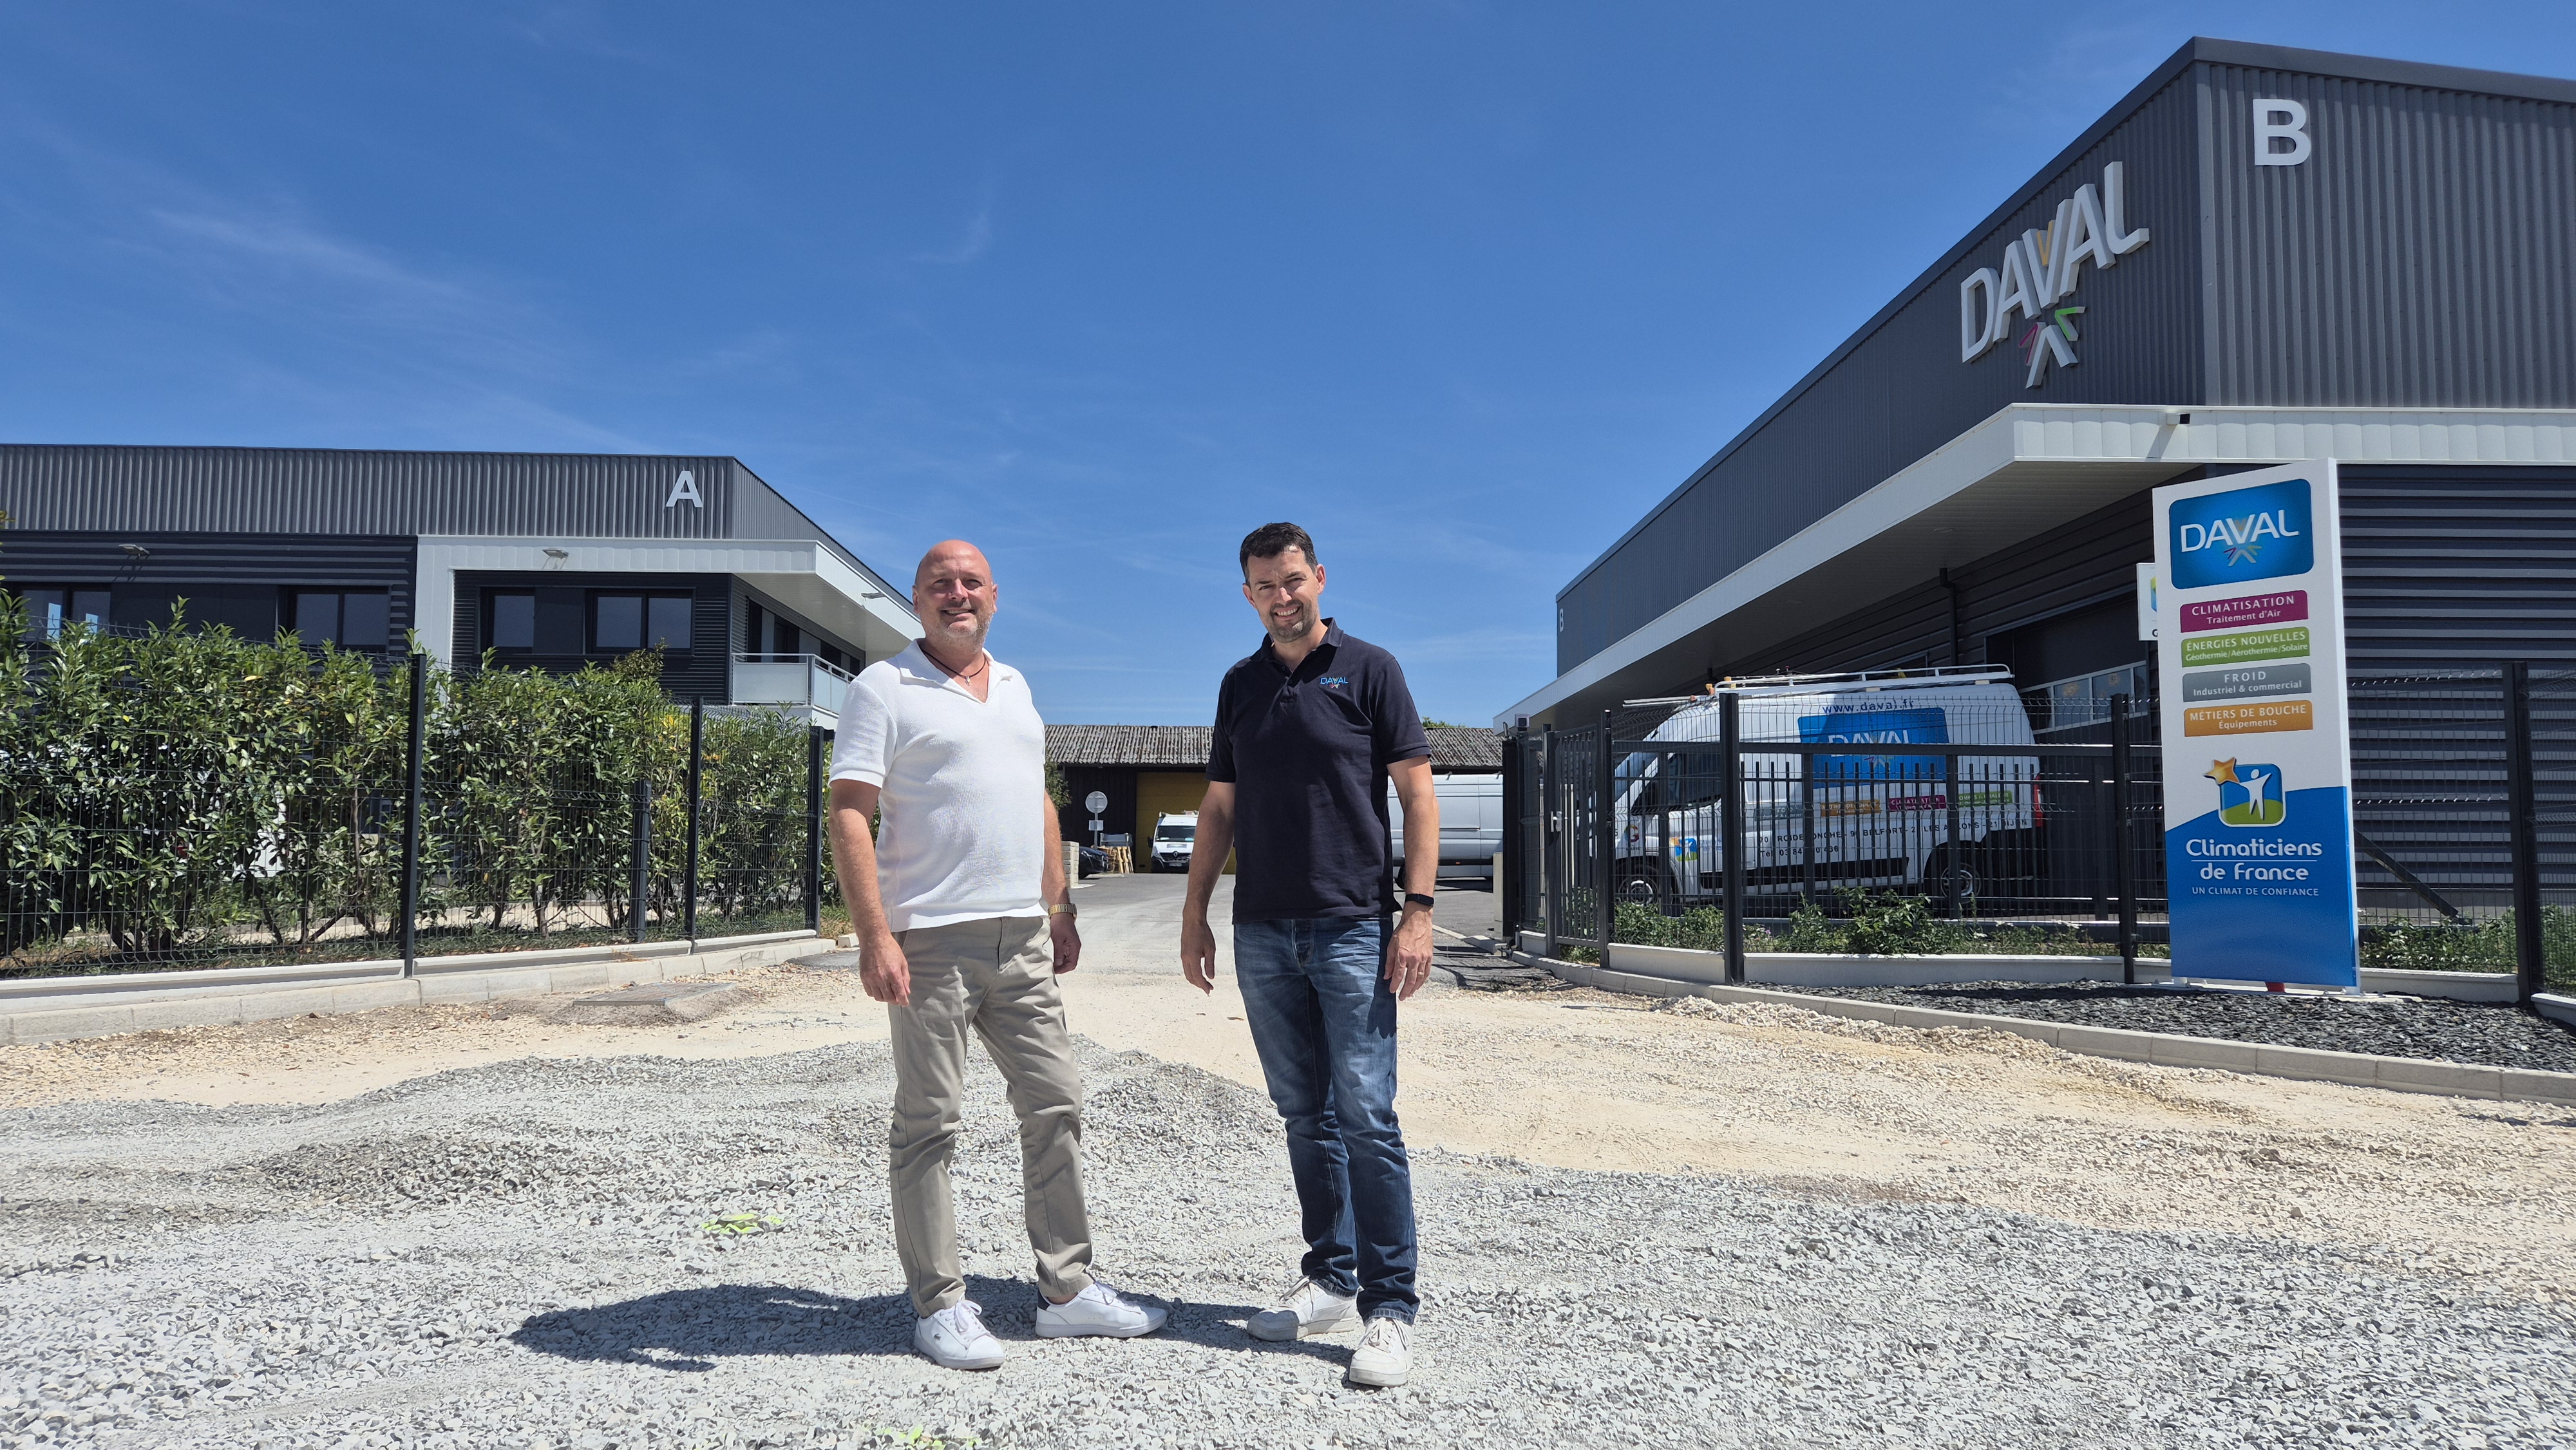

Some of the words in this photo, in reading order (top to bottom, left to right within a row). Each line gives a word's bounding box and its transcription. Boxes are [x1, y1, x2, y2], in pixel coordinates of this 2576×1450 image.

[2252, 99, 2312, 166] B
[1960, 160, 2150, 364] DAVAL
[665, 470, 703, 508] A
[2180, 509, 2300, 552] DAVAL
[2192, 595, 2295, 616] CLIMATISATION
[1559, 608, 1564, 632] B
[2206, 612, 2256, 625] Traitement
[2259, 609, 2282, 619] d'Air
[2186, 637, 2237, 651] ÉNERGIES
[2240, 630, 2306, 646] NOUVELLES
[2224, 671, 2266, 683] FROID
[2193, 685, 2236, 696] Industriel
[2239, 684, 2246, 693] &
[2248, 680, 2302, 692] commercial
[1822, 699, 1914, 713] www.daval.fr
[2190, 710, 2236, 720] MÉTIERS
[2240, 708, 2255, 717] DE
[2259, 704, 2307, 716] BOUCHE
[2219, 719, 2278, 730] Équipements
[2186, 838, 2322, 857] Climaticiens
[2199, 862, 2226, 880] de
[2192, 887, 2206, 895] UN
[2208, 887, 2242, 896] CLIMAT
[2246, 887, 2259, 896] DE
[2261, 887, 2320, 896] CONFIANCE
